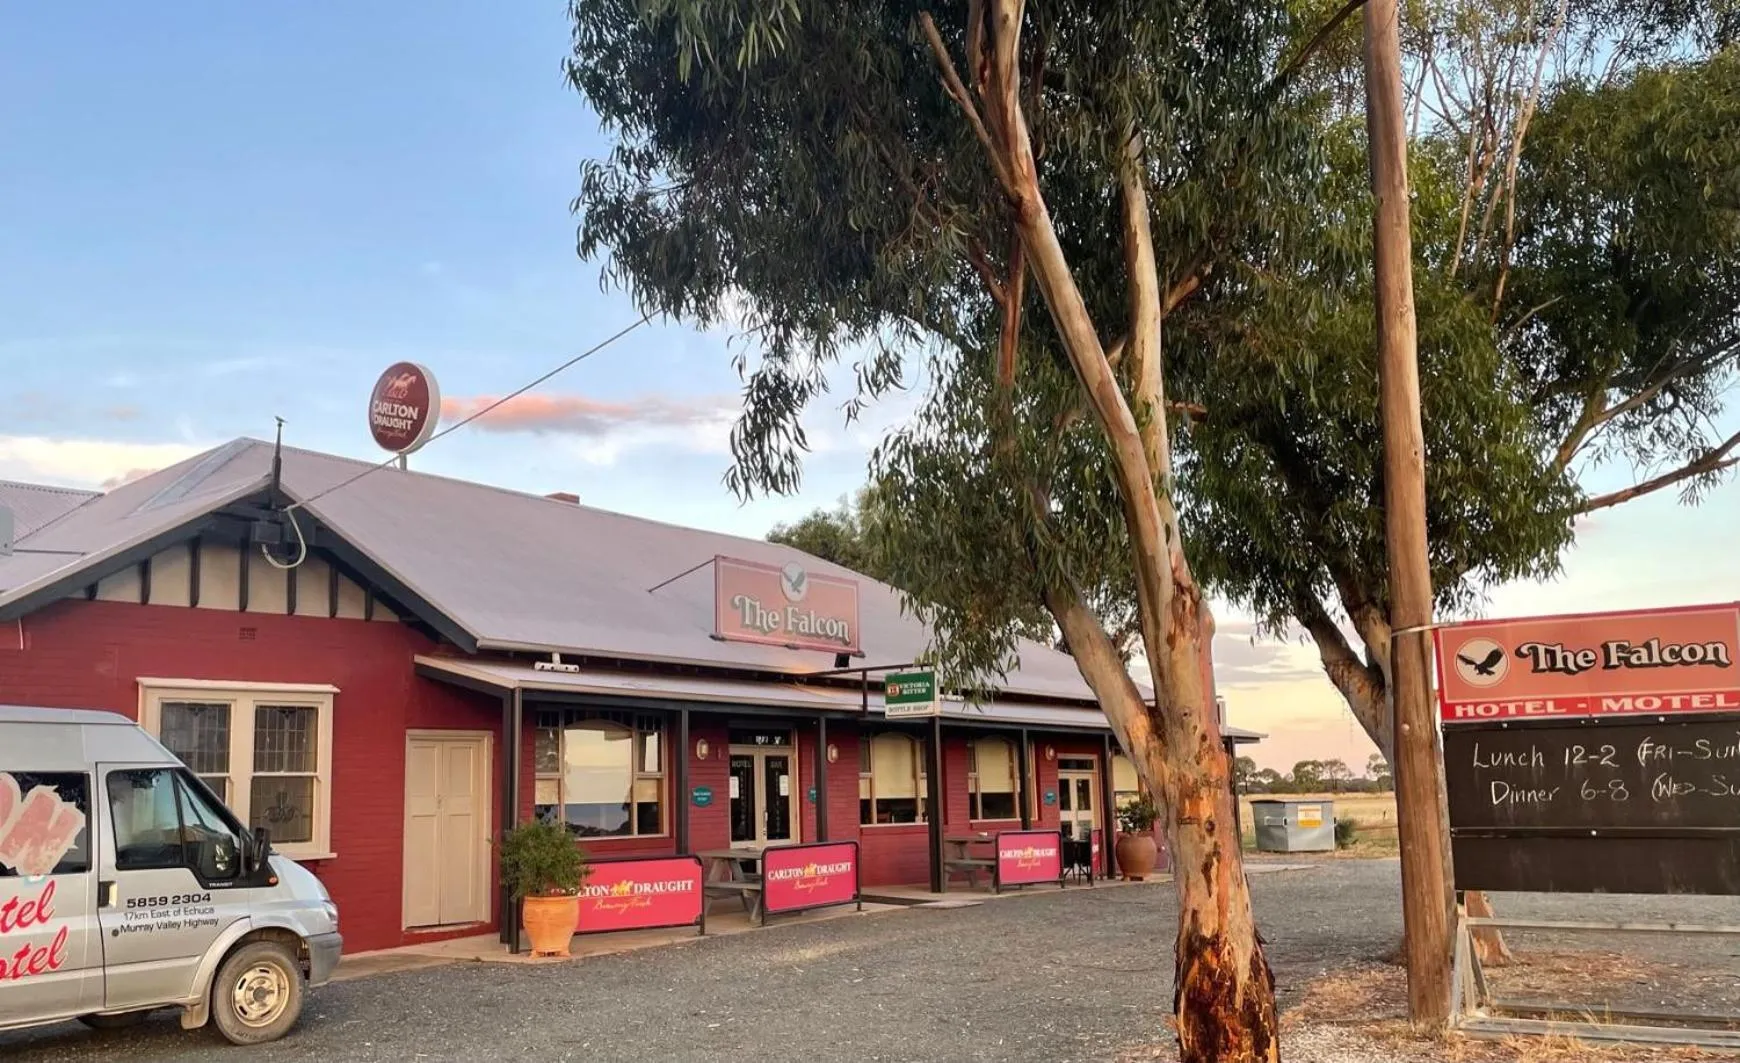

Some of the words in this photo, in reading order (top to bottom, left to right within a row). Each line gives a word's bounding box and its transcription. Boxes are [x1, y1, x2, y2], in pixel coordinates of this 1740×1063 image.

[373, 401, 418, 419] CARLTON
[373, 415, 413, 430] DRAUGHT
[732, 594, 780, 635] The
[783, 606, 851, 644] Falcon
[1515, 641, 1597, 675] The
[1602, 637, 1732, 669] Falcon
[1454, 701, 1567, 717] HOTEL
[1602, 694, 1740, 712] MOTEL
[1473, 742, 1544, 768] Lunch
[1564, 744, 1620, 767] 12-2
[1491, 780, 1559, 804] Dinner
[1580, 779, 1629, 801] 6-8
[768, 867, 804, 880] CARLTON
[816, 862, 852, 875] DRAUGHT
[634, 880, 693, 894] DRAUGHT
[127, 896, 168, 908] 5859
[172, 893, 211, 905] 2304
[124, 910, 148, 920] 17km
[151, 908, 171, 919] East
[173, 907, 181, 916] of
[184, 906, 214, 916] Echuca
[120, 923, 153, 934] Murray
[156, 920, 181, 930] Valley
[184, 917, 219, 928] Highway
